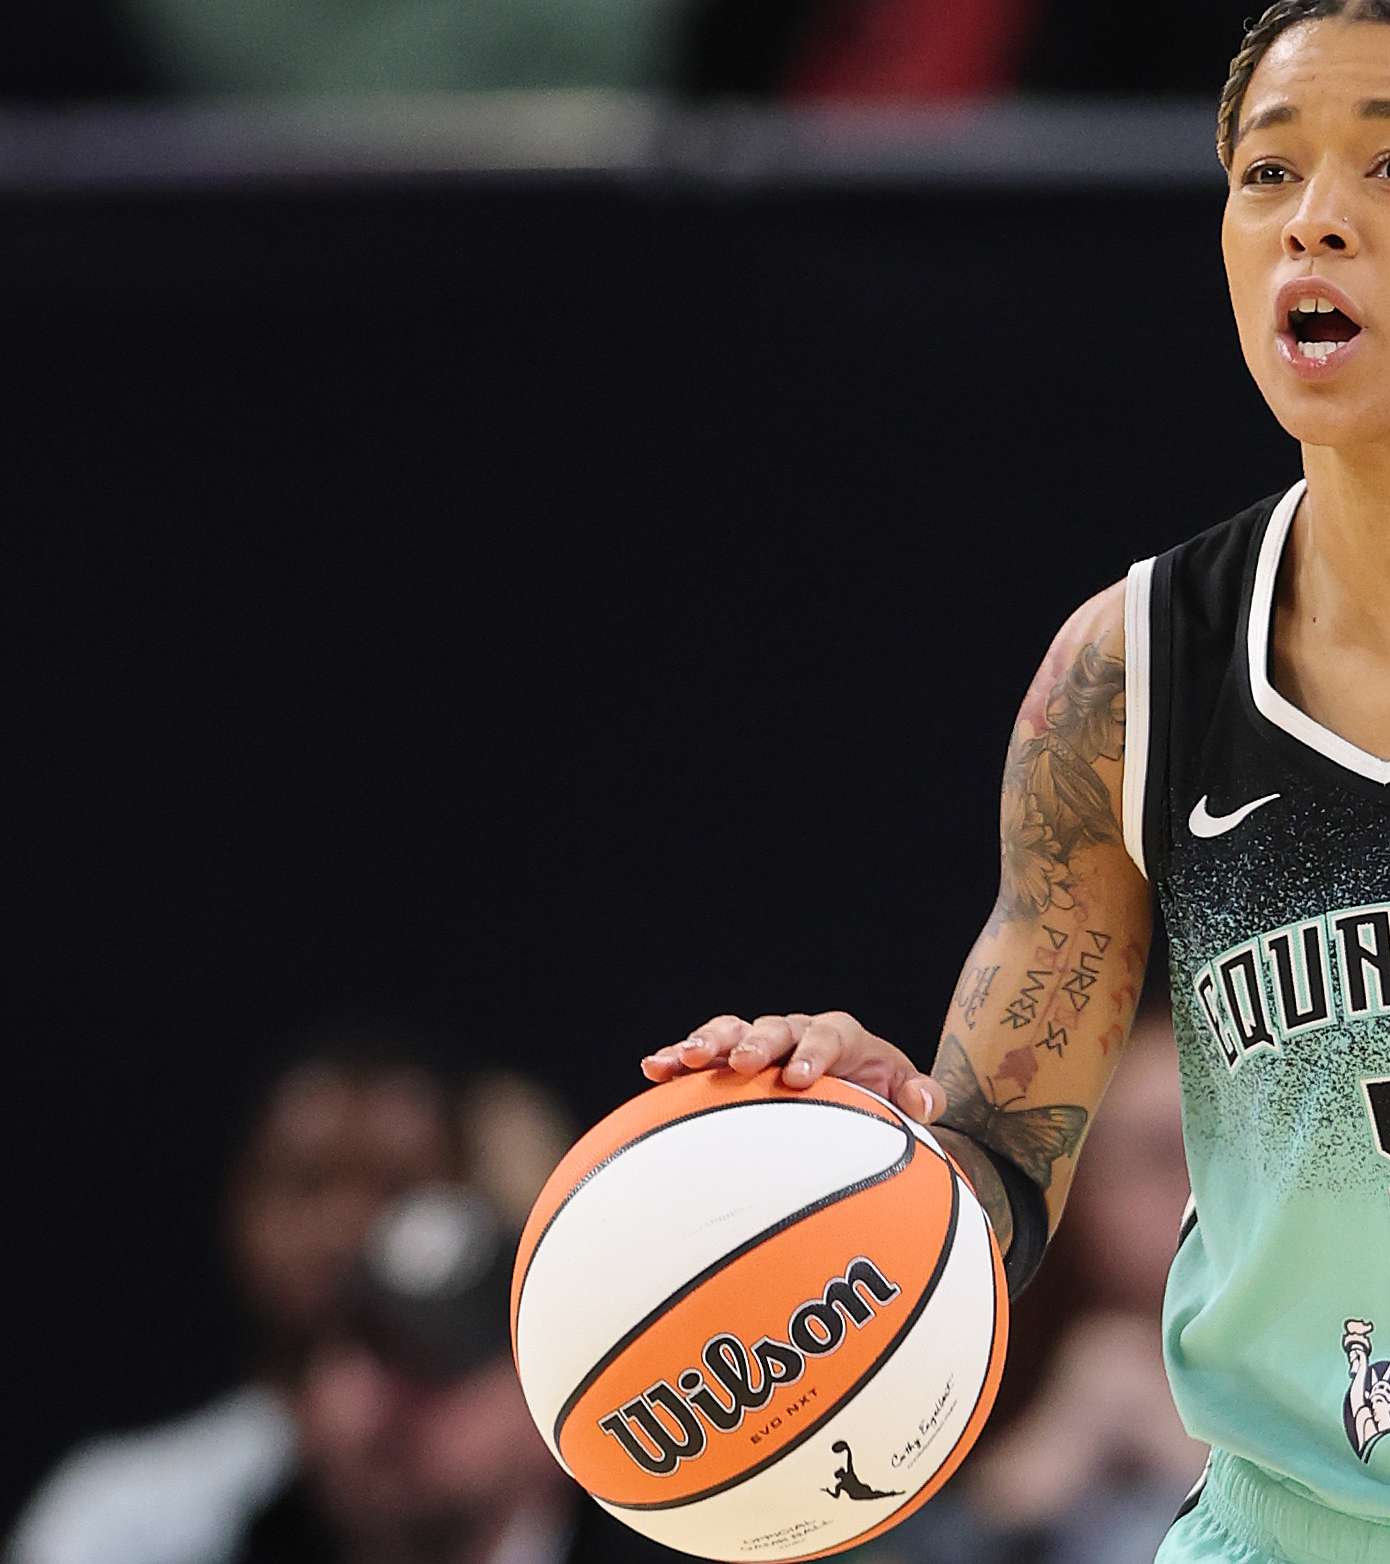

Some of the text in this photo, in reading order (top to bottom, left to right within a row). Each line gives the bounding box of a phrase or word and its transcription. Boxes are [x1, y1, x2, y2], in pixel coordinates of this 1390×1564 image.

[597, 1256, 902, 1478] Wilson
[750, 1387, 818, 1445] EVO NXT
